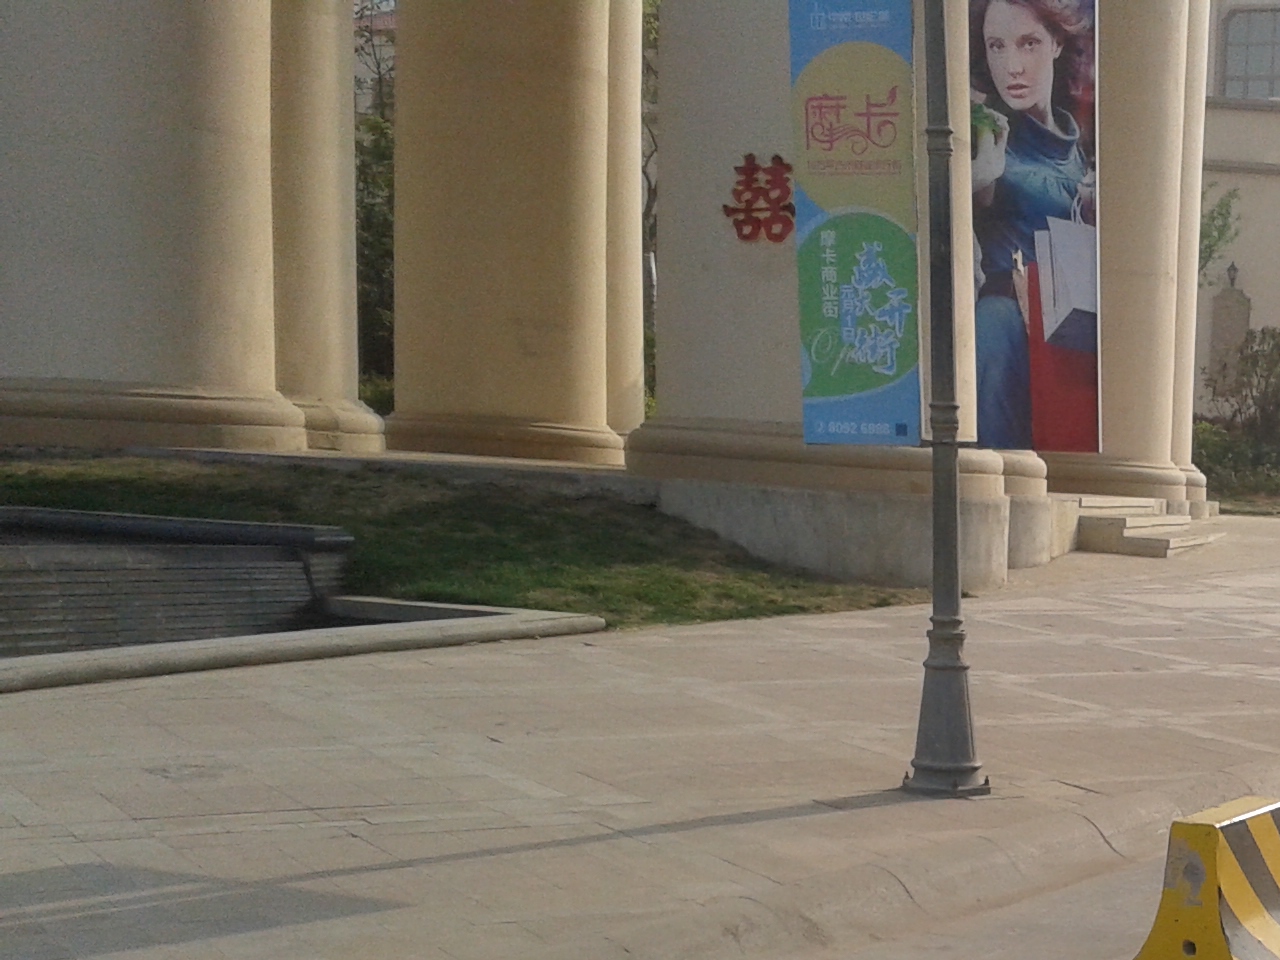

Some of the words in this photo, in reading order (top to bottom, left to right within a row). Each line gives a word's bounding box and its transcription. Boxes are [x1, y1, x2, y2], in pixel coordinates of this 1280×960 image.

[804, 86, 900, 156] 摩卡
[820, 229, 839, 319] 摩卡商业街
